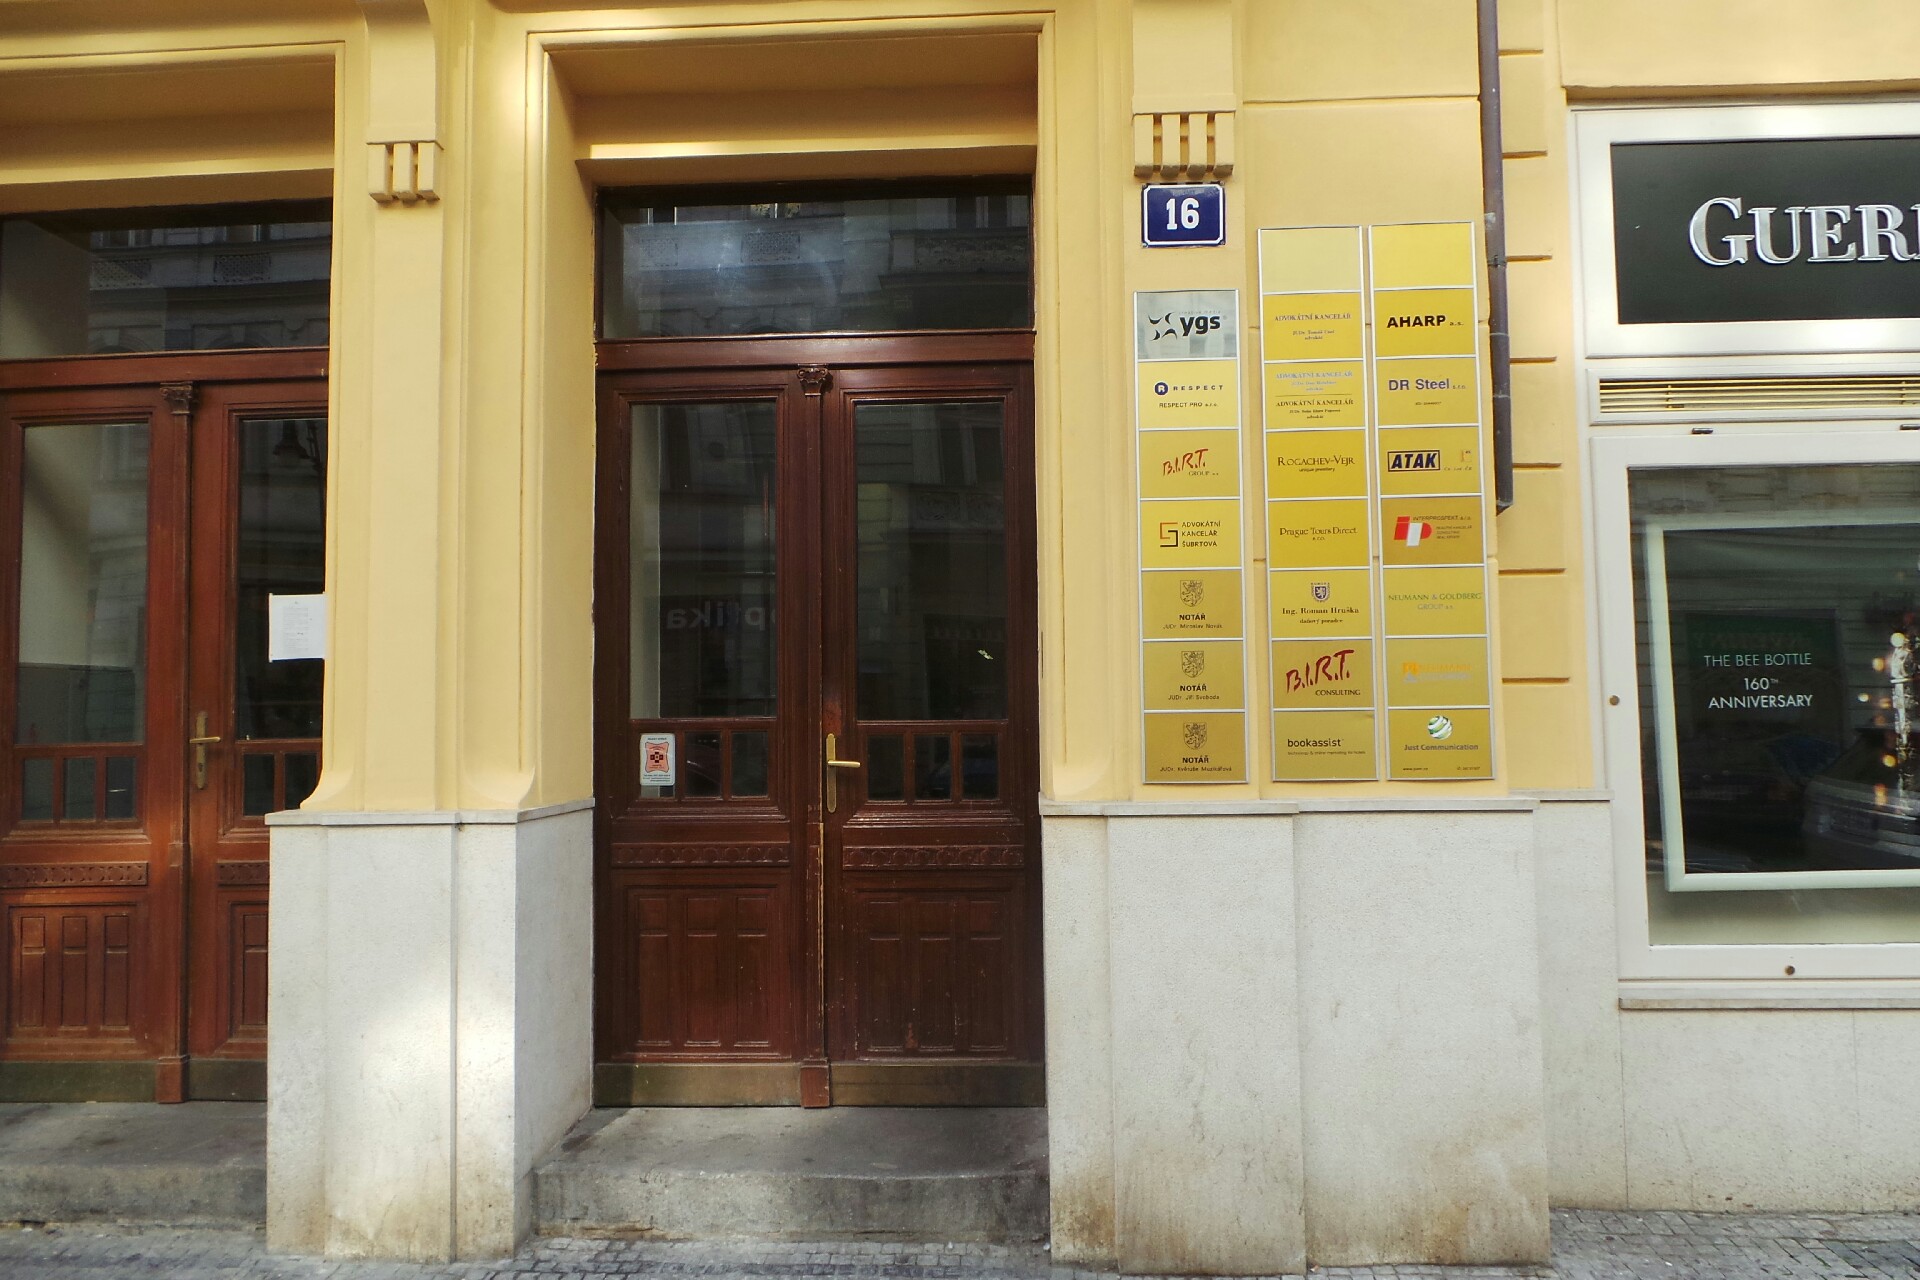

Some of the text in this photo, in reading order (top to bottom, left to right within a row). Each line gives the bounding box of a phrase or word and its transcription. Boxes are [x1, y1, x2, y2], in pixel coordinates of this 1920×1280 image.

[1166, 197, 1200, 230] 16
[1274, 312, 1352, 322] ADVOKÁTNÍ KANCELÁŘ
[1386, 315, 1446, 328] AHARP
[1180, 316, 1220, 336] ygs
[1388, 380, 1410, 390] DR
[1415, 378, 1449, 390] Steel
[1276, 399, 1355, 408] ADVOKÁTNÍ KANCELÁŘ
[1163, 448, 1208, 476] B.I.R.T.
[1391, 453, 1437, 469] ATAK
[1181, 520, 1221, 528] ADVOKÁTNÍ
[1181, 529, 1218, 537] KANCELÁŘ
[1279, 526, 1357, 538] Prague Tours Direct
[1439, 592, 1482, 600] GOLDBERG
[1282, 608, 1298, 616] Ing.
[1330, 606, 1360, 615] Hruška
[1179, 613, 1206, 621] NOTÁŘ
[1704, 652, 1812, 667] THE BEE BOTTLE
[1286, 649, 1355, 694] B.I.R.T.
[1179, 683, 1207, 692] NOTÁŘ
[1708, 694, 1813, 709] ANNIVERSARY
[1287, 738, 1341, 748] bookassist
[1420, 743, 1479, 751] Communication
[1182, 754, 1209, 764] NOTÁŘ
